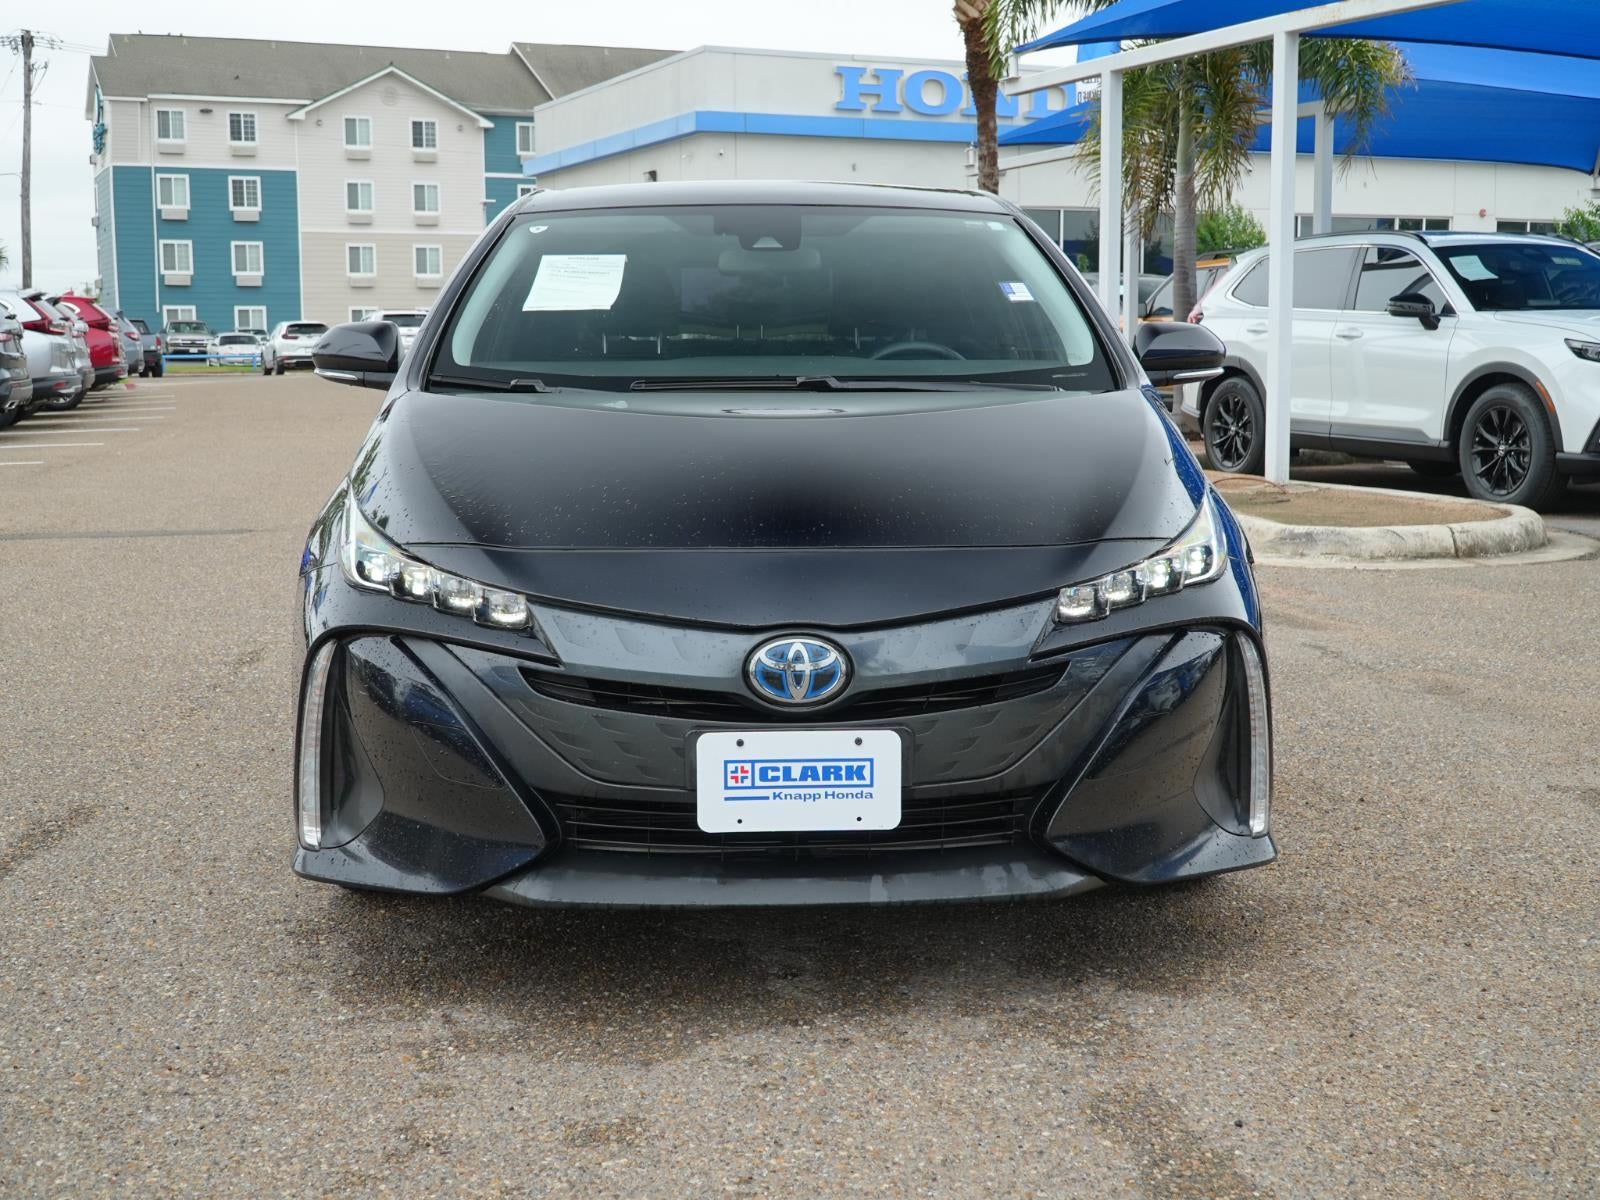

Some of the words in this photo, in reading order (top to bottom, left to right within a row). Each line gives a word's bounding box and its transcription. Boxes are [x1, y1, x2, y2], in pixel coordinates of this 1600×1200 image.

[759, 765, 866, 782] CLARK
[772, 791, 822, 801] Knapp
[824, 790, 873, 800] Honda
